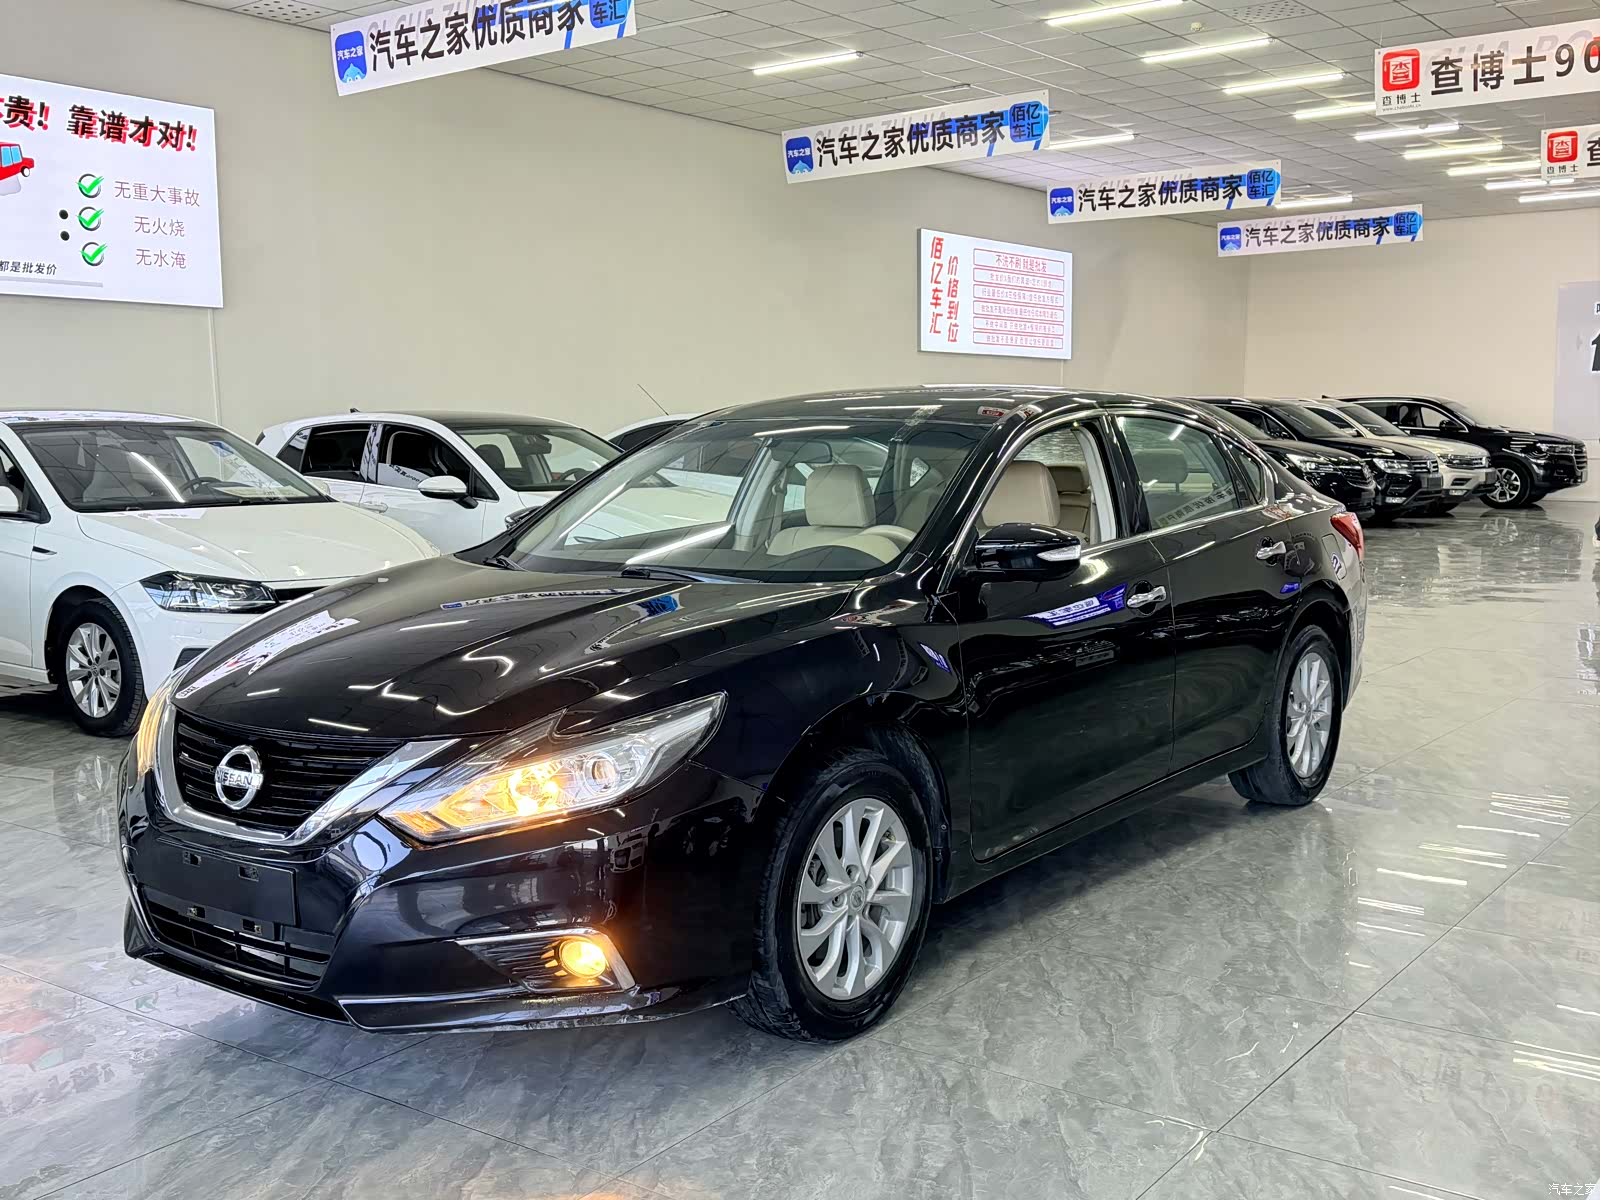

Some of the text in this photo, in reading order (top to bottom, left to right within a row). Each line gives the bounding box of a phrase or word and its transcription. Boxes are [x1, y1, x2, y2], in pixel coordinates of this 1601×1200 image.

[370, 0, 584, 71] 汽车之家优质商家
[337, 45, 364, 61] 汽车之家
[0, 95, 49, 131] 贵！
[787, 147, 811, 158] 汽车之家
[816, 111, 1005, 168] 汽车之家优质商家
[114, 180, 200, 207] 无重大事故
[1078, 174, 1243, 213] 汽车之家优质商家
[134, 215, 185, 238] 无火烧
[1245, 216, 1391, 248] 汽车之家优质商家
[0, 259, 57, 275] 都是批发价
[135, 248, 187, 270] 无水淹
[930, 236, 944, 334] 佰亿车汇
[946, 255, 960, 343] 价格到位
